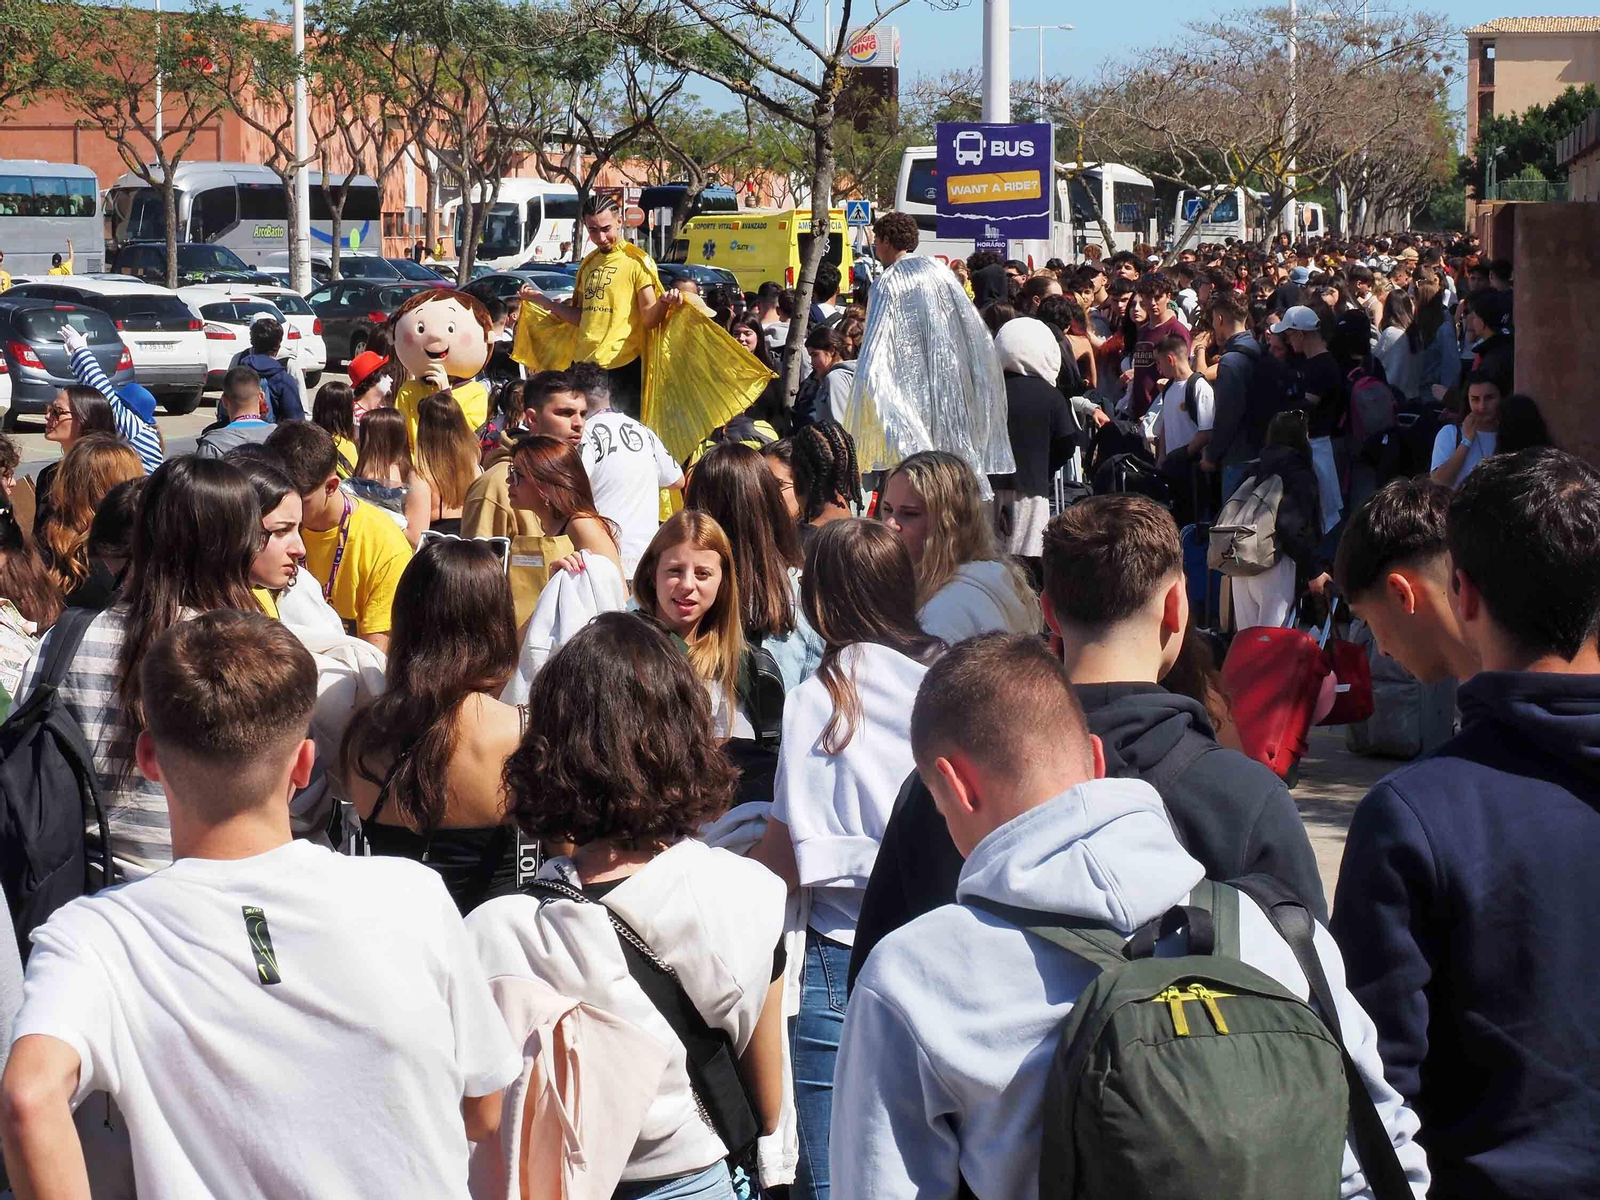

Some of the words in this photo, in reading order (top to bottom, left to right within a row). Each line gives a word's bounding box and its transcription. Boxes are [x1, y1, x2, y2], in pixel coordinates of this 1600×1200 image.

[850, 41, 876, 55] KING
[990, 140, 1035, 157] BUS
[950, 184, 989, 196] WANT
[991, 183, 1001, 193] A
[1003, 180, 1038, 192] RIDE?
[976, 240, 1006, 248] HORÁRIO
